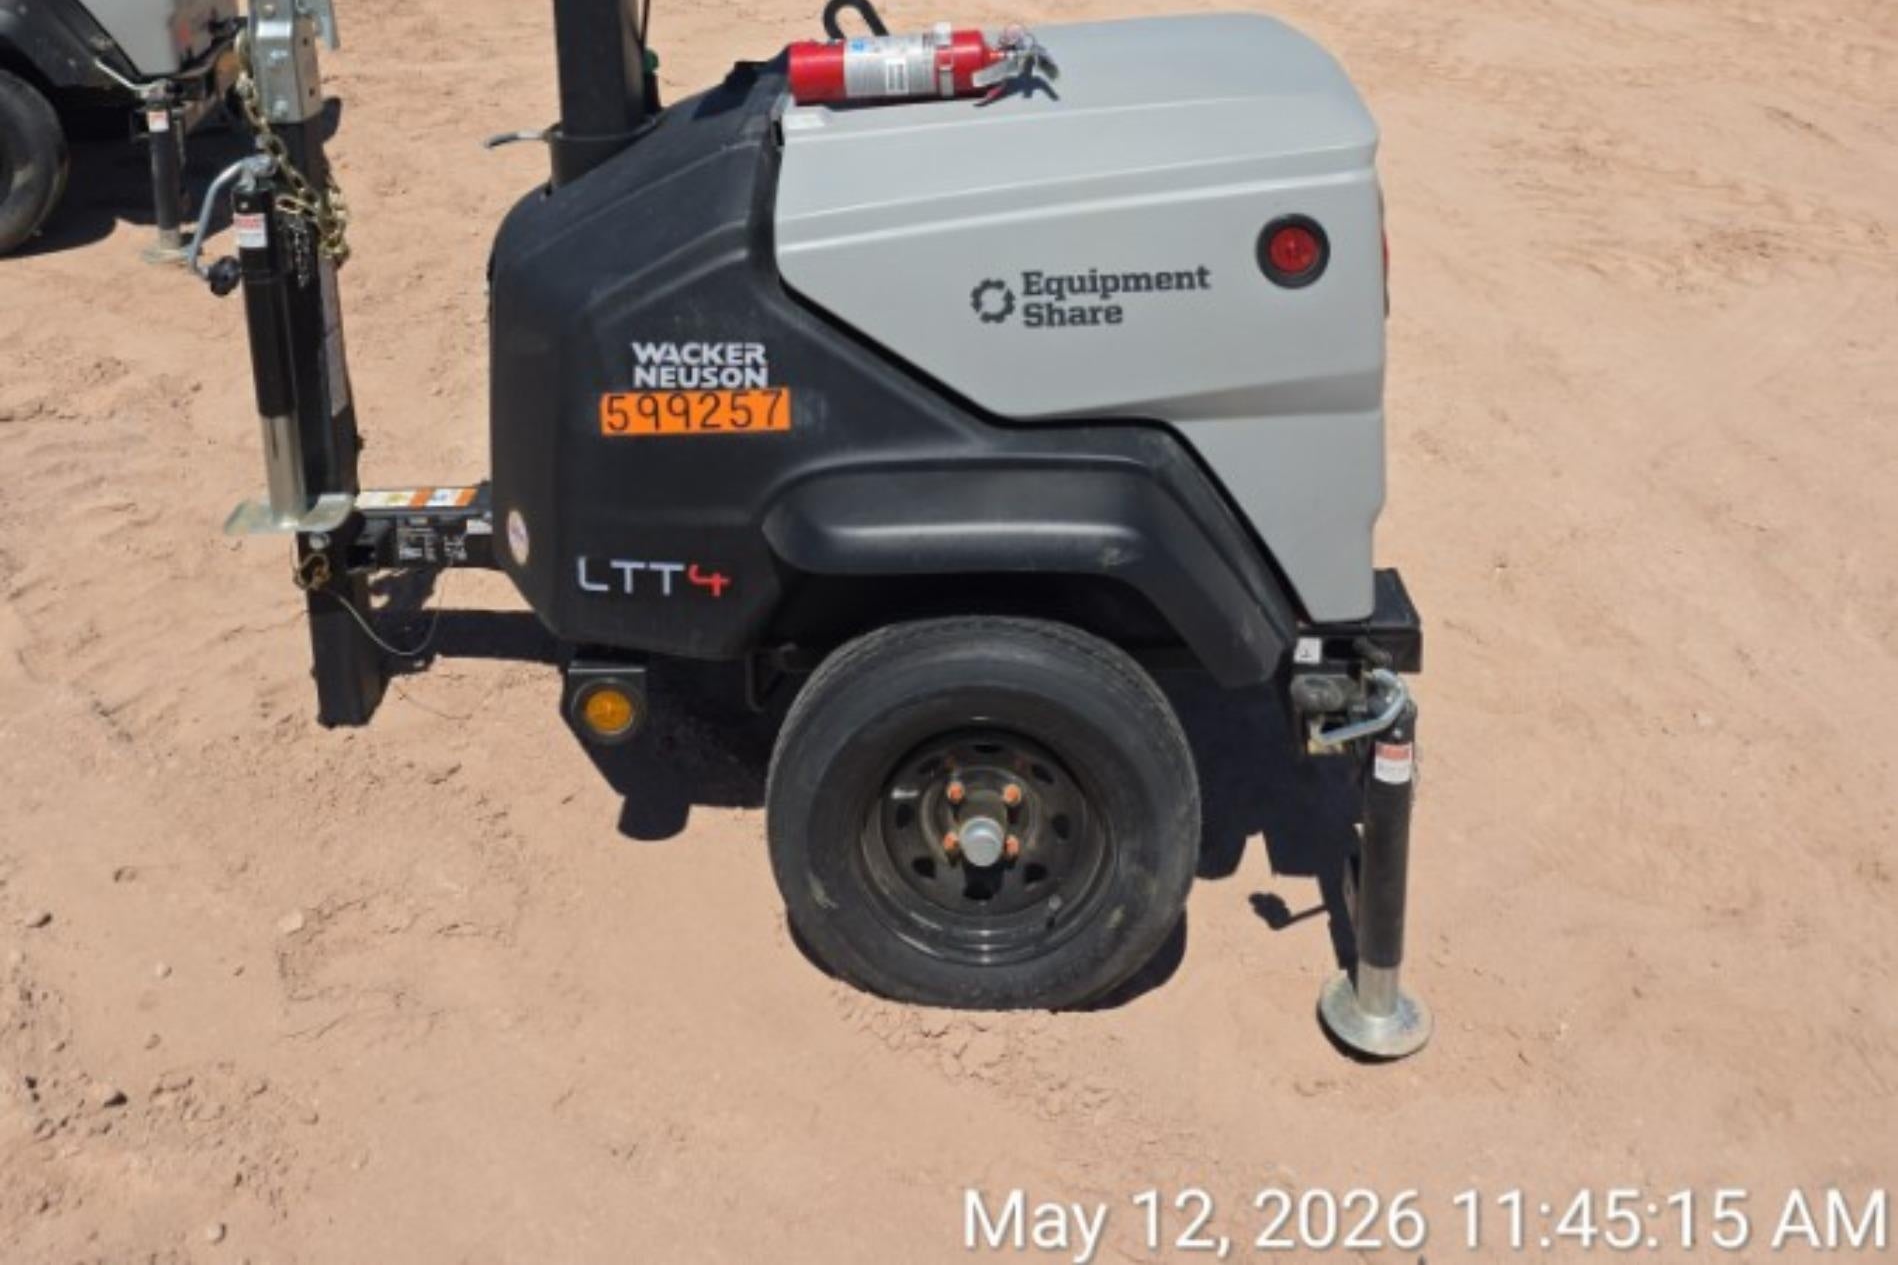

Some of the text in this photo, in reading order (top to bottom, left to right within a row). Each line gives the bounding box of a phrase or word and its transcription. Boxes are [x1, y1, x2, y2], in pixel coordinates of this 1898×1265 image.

[1021, 265, 1211, 301] Equipment
[1022, 301, 1123, 329] Share
[631, 341, 767, 366] WACKER
[633, 366, 768, 388] NEUSON
[606, 390, 783, 432] 599257
[577, 556, 730, 597] LTT4
